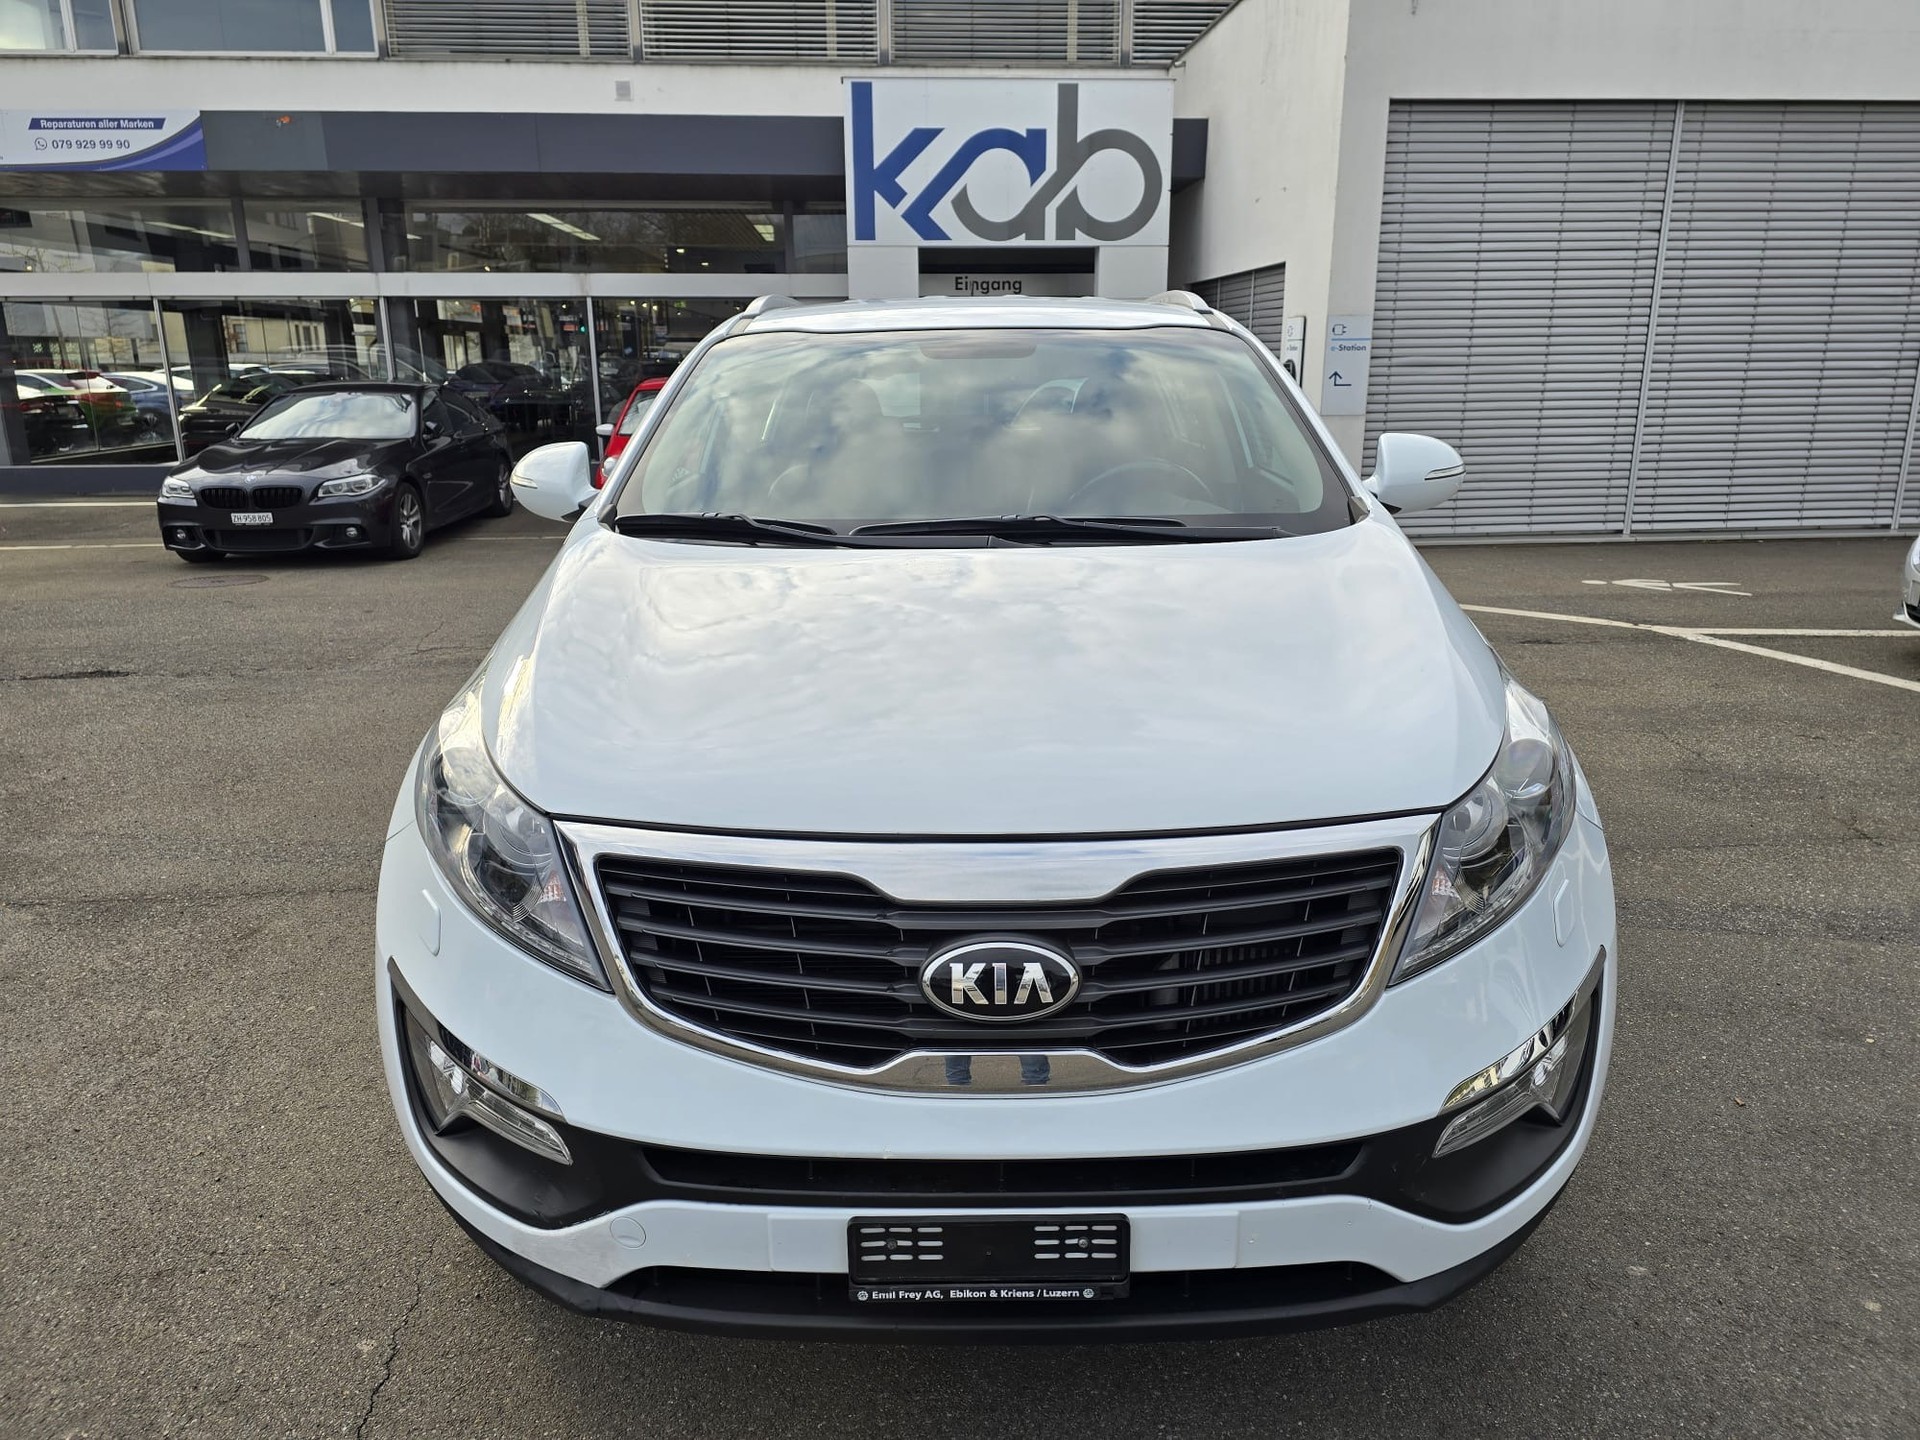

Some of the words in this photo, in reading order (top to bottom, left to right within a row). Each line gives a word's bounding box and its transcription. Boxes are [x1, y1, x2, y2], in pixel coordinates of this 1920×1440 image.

[40, 119, 97, 130] Reparaturen
[98, 120, 119, 129] aller
[120, 120, 154, 129] Marken
[52, 140, 73, 149] 079
[75, 139, 96, 149] 929
[99, 139, 113, 149] 99
[116, 139, 130, 149] 90
[955, 276, 1022, 294] Eingang
[1330, 343, 1367, 352] e-Station
[949, 962, 1054, 1005] KIA
[872, 1290, 896, 1300] Emil
[899, 1290, 922, 1301] Frey
[924, 1290, 944, 1300] AG,
[950, 1289, 987, 1299] Ebikon
[989, 1289, 998, 1299] &
[1000, 1288, 1035, 1298] Kriens
[1043, 1287, 1080, 1298] Luzern
